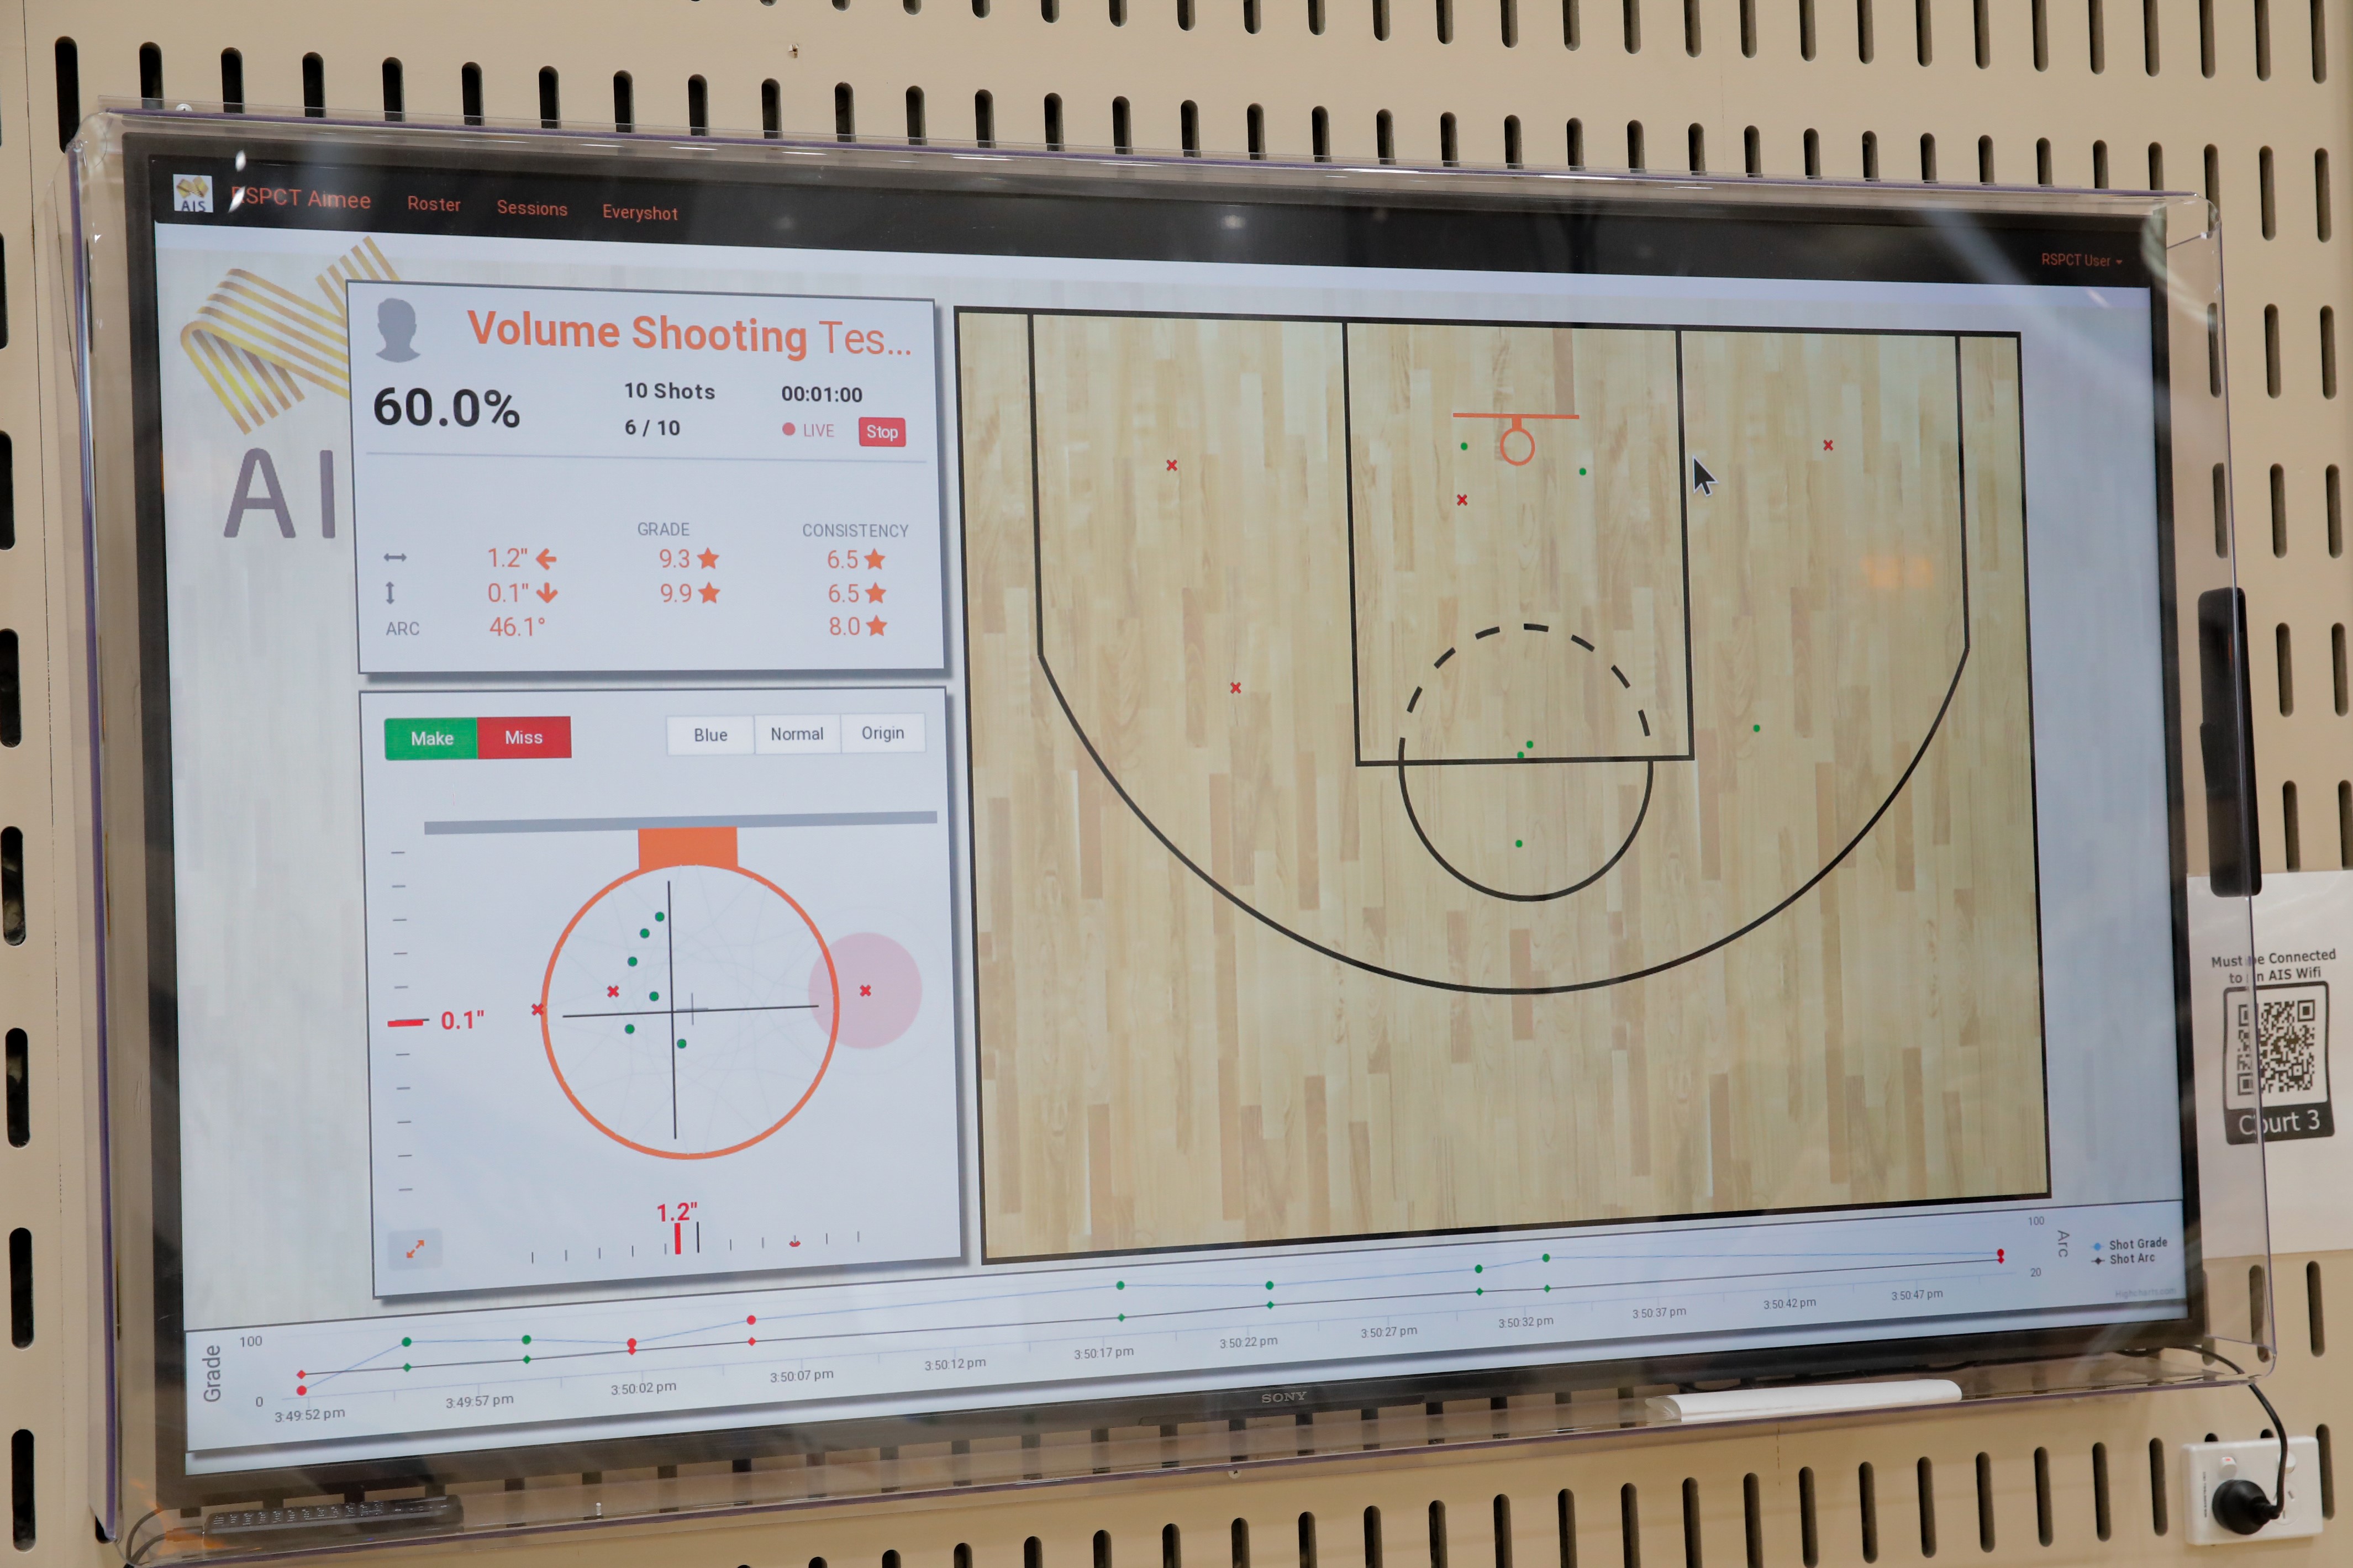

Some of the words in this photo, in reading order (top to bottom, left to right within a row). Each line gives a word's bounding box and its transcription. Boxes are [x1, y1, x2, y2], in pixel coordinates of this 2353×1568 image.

[181, 200, 206, 212] AIS
[308, 189, 371, 209] Aimee
[408, 196, 461, 211] Roster
[498, 200, 567, 216] Sessions
[603, 204, 677, 223] Everyshot
[2043, 253, 2081, 266] RSPCT
[2085, 255, 2110, 266] User
[467, 310, 619, 347] Volume
[633, 315, 807, 361] Shooting
[819, 321, 910, 355] Tes...
[625, 383, 647, 398] 10
[655, 382, 715, 399] Shots
[782, 386, 862, 402] 00:01:00
[374, 387, 519, 427] 60.0%
[625, 420, 636, 435] 6
[643, 420, 650, 437] /
[658, 420, 680, 435] 10
[804, 424, 834, 437] LIVE
[867, 425, 898, 441] Stop
[638, 522, 689, 536] GRADE
[803, 524, 908, 537] CONSISTENCY
[488, 548, 527, 567] 1.2"
[660, 549, 689, 568] 9.3
[828, 550, 858, 568] 6.5
[488, 583, 528, 602] 0.1"
[661, 584, 692, 603] 9.9
[829, 584, 859, 603] 6.5
[386, 622, 419, 635] ARC
[489, 617, 545, 636] 46.1°
[830, 617, 860, 635] 8.0
[412, 732, 454, 745] Make
[506, 731, 543, 744] Miss
[695, 728, 727, 742] Blue
[772, 727, 823, 740] Normal
[862, 726, 904, 742] Origin
[2212, 956, 2242, 967] Must
[2269, 949, 2336, 964] Connected
[2230, 974, 2242, 983] to
[2270, 969, 2291, 980] AIS
[2296, 966, 2322, 978] Wifi
[441, 1010, 484, 1030] 0.1"
[2308, 1110, 2320, 1129] 3
[657, 1202, 697, 1222] 1.2"
[2029, 1216, 2044, 1226] 100
[2058, 1231, 2070, 1257] Arc
[2110, 1239, 2134, 1250] Shot
[2138, 1237, 2167, 1248] Grade
[2110, 1254, 2134, 1264] Shot
[2138, 1253, 2154, 1262] Arc
[2031, 1268, 2041, 1277] 20
[1892, 1290, 1924, 1301] 3:50:47
[1927, 1291, 1943, 1300] pm
[1764, 1298, 1797, 1309] 3:50:42
[1800, 1300, 1816, 1309] pm
[1633, 1307, 1667, 1318] 3:50:37
[1670, 1308, 1686, 1318] pm
[1499, 1317, 1534, 1328] 3:50:32
[1537, 1318, 1554, 1327] pm
[1361, 1327, 1397, 1338] 3:50:27
[1400, 1327, 1417, 1337] pm
[240, 1336, 262, 1347] 100
[1220, 1337, 1257, 1349] 3:50:22
[1260, 1338, 1278, 1348] pm
[1075, 1348, 1112, 1359] 3:50:17
[1116, 1348, 1134, 1359] pm
[925, 1359, 964, 1371] 3:50:12
[967, 1359, 986, 1370] pm
[202, 1345, 220, 1402] Grade
[771, 1370, 810, 1382] 3:50:07
[815, 1371, 833, 1382] pm
[612, 1382, 653, 1395] 3:50:02
[657, 1383, 676, 1394] pm
[256, 1397, 263, 1407] 0
[446, 1395, 489, 1408] 3:49:57
[493, 1396, 513, 1407] pm
[1262, 1391, 1307, 1403] SONY
[275, 1409, 320, 1422] 3:49:52
[324, 1409, 345, 1421] pm
